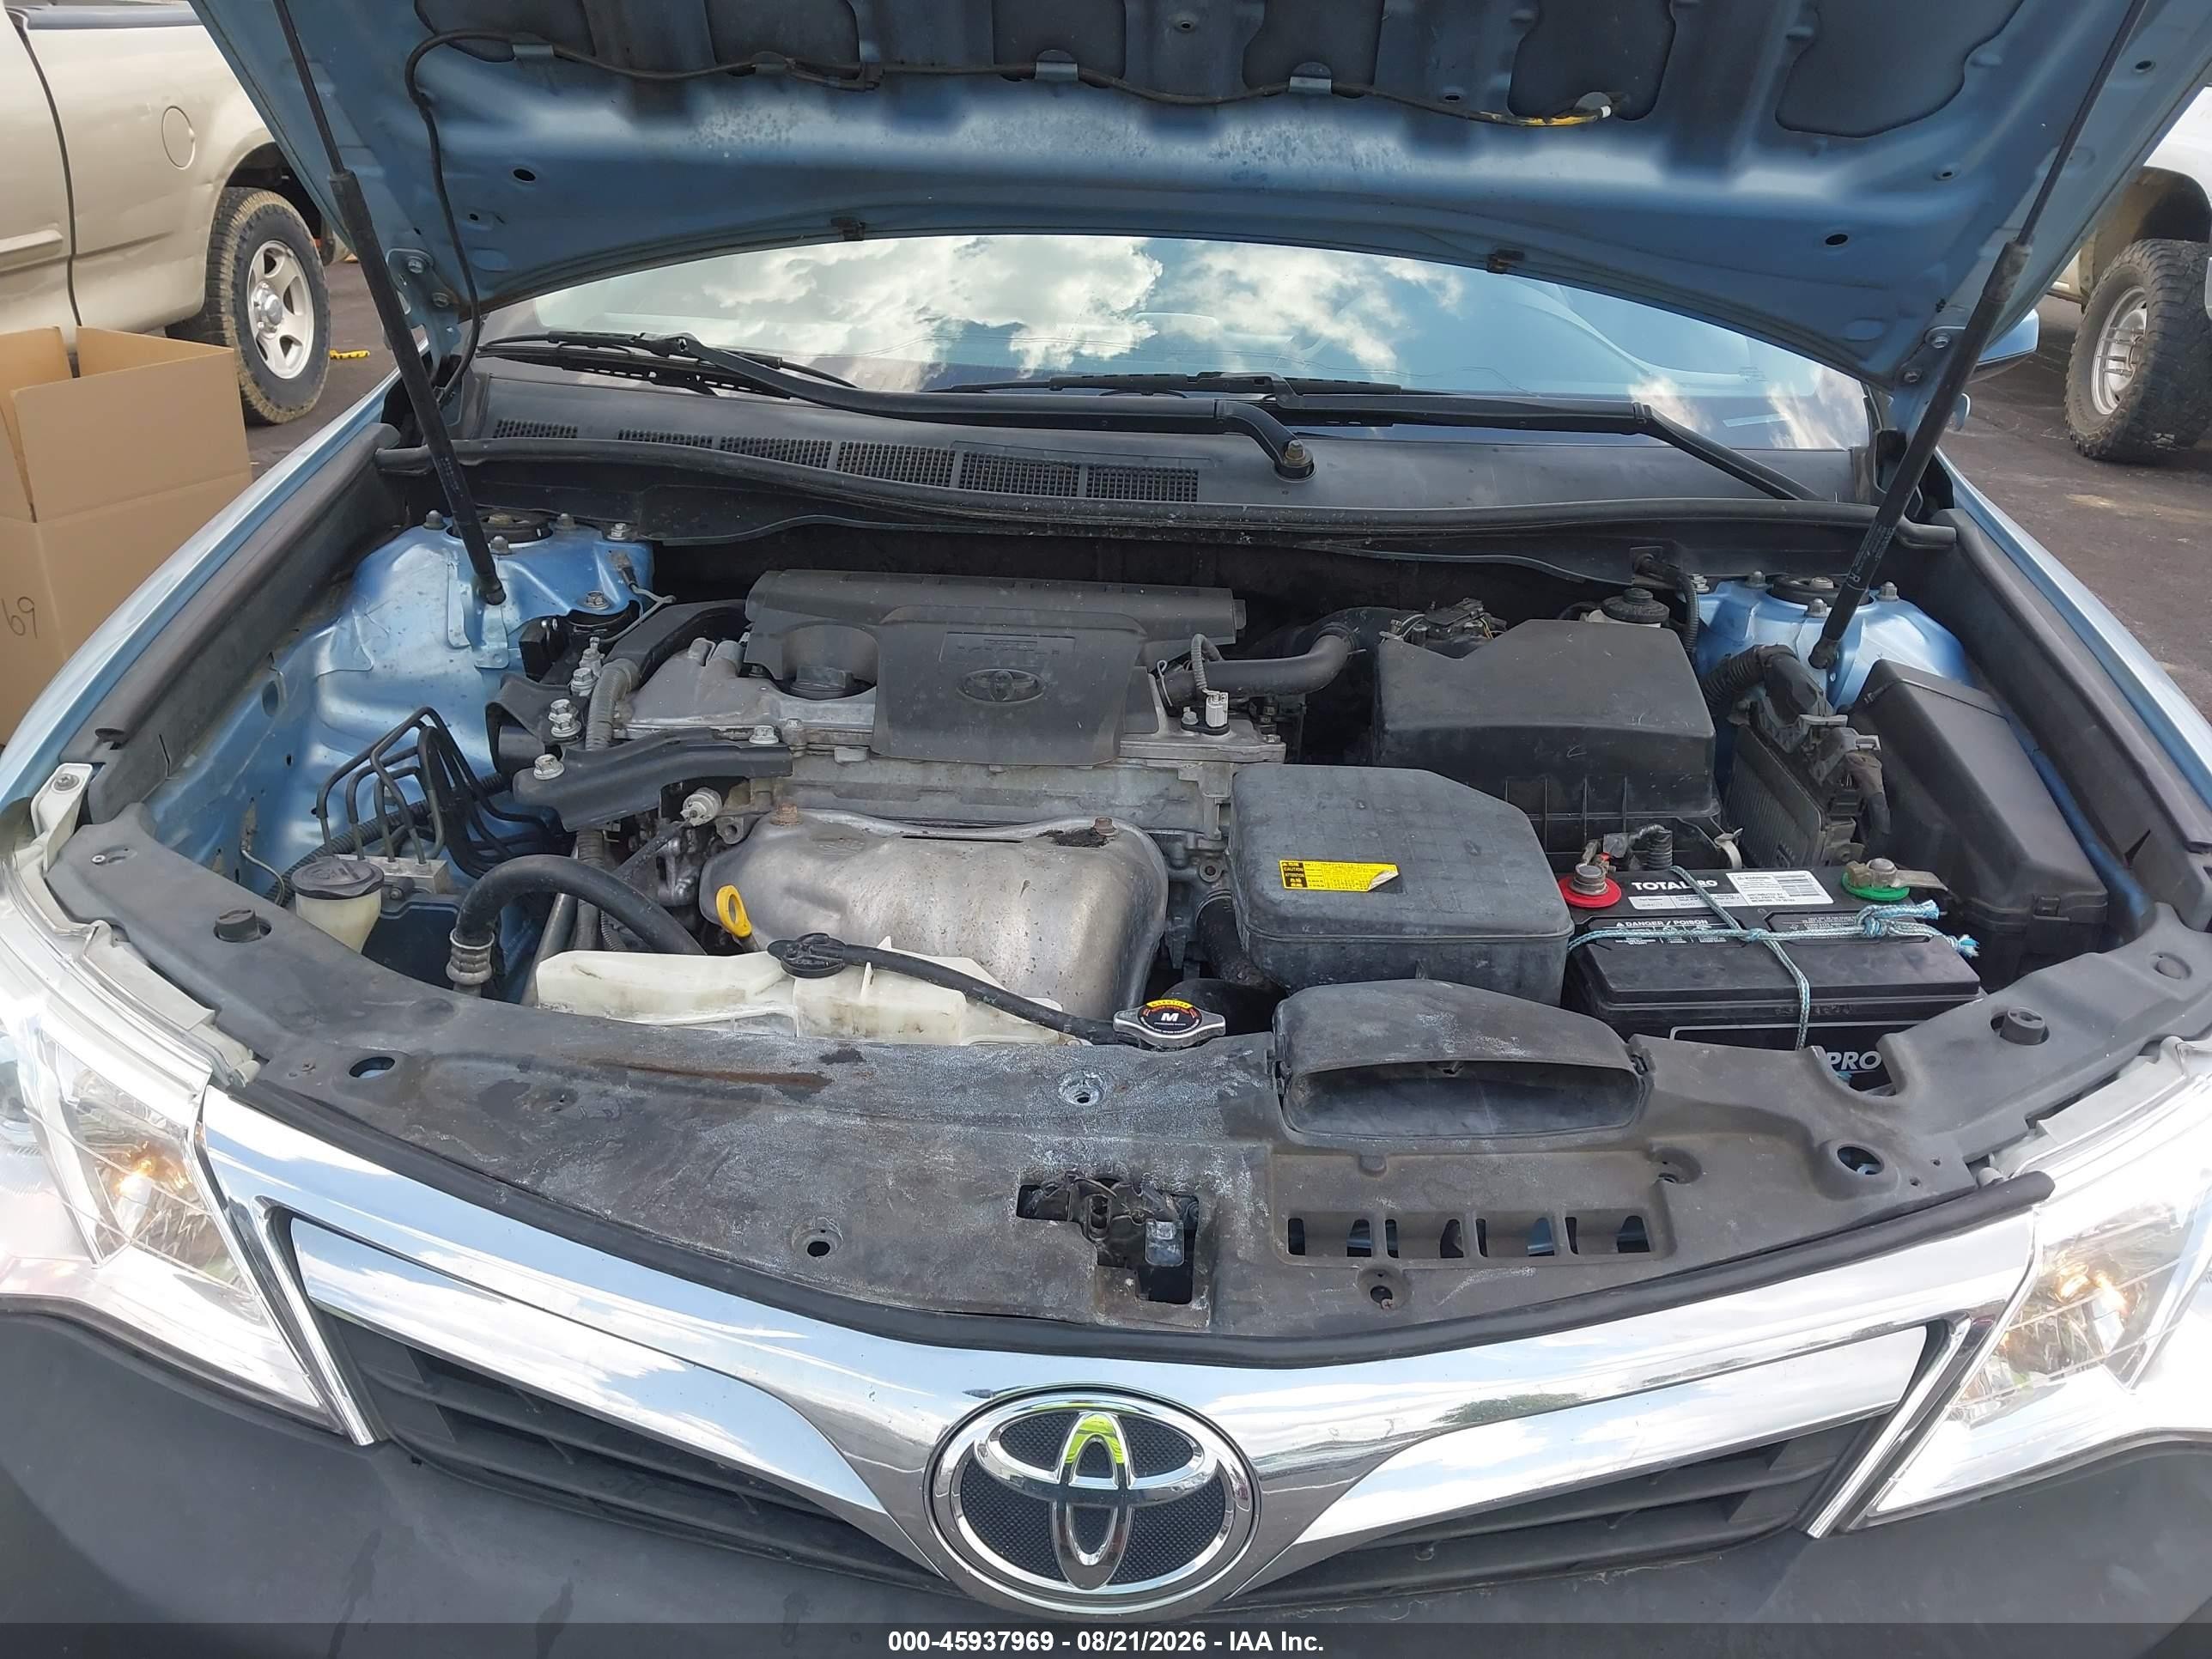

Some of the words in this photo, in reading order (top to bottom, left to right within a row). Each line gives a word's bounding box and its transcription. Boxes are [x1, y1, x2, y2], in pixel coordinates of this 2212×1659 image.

[1, 596, 38, 639] 69
[1632, 880, 1717, 890] TOTALRO
[1826, 1051, 1882, 1070] PRO
